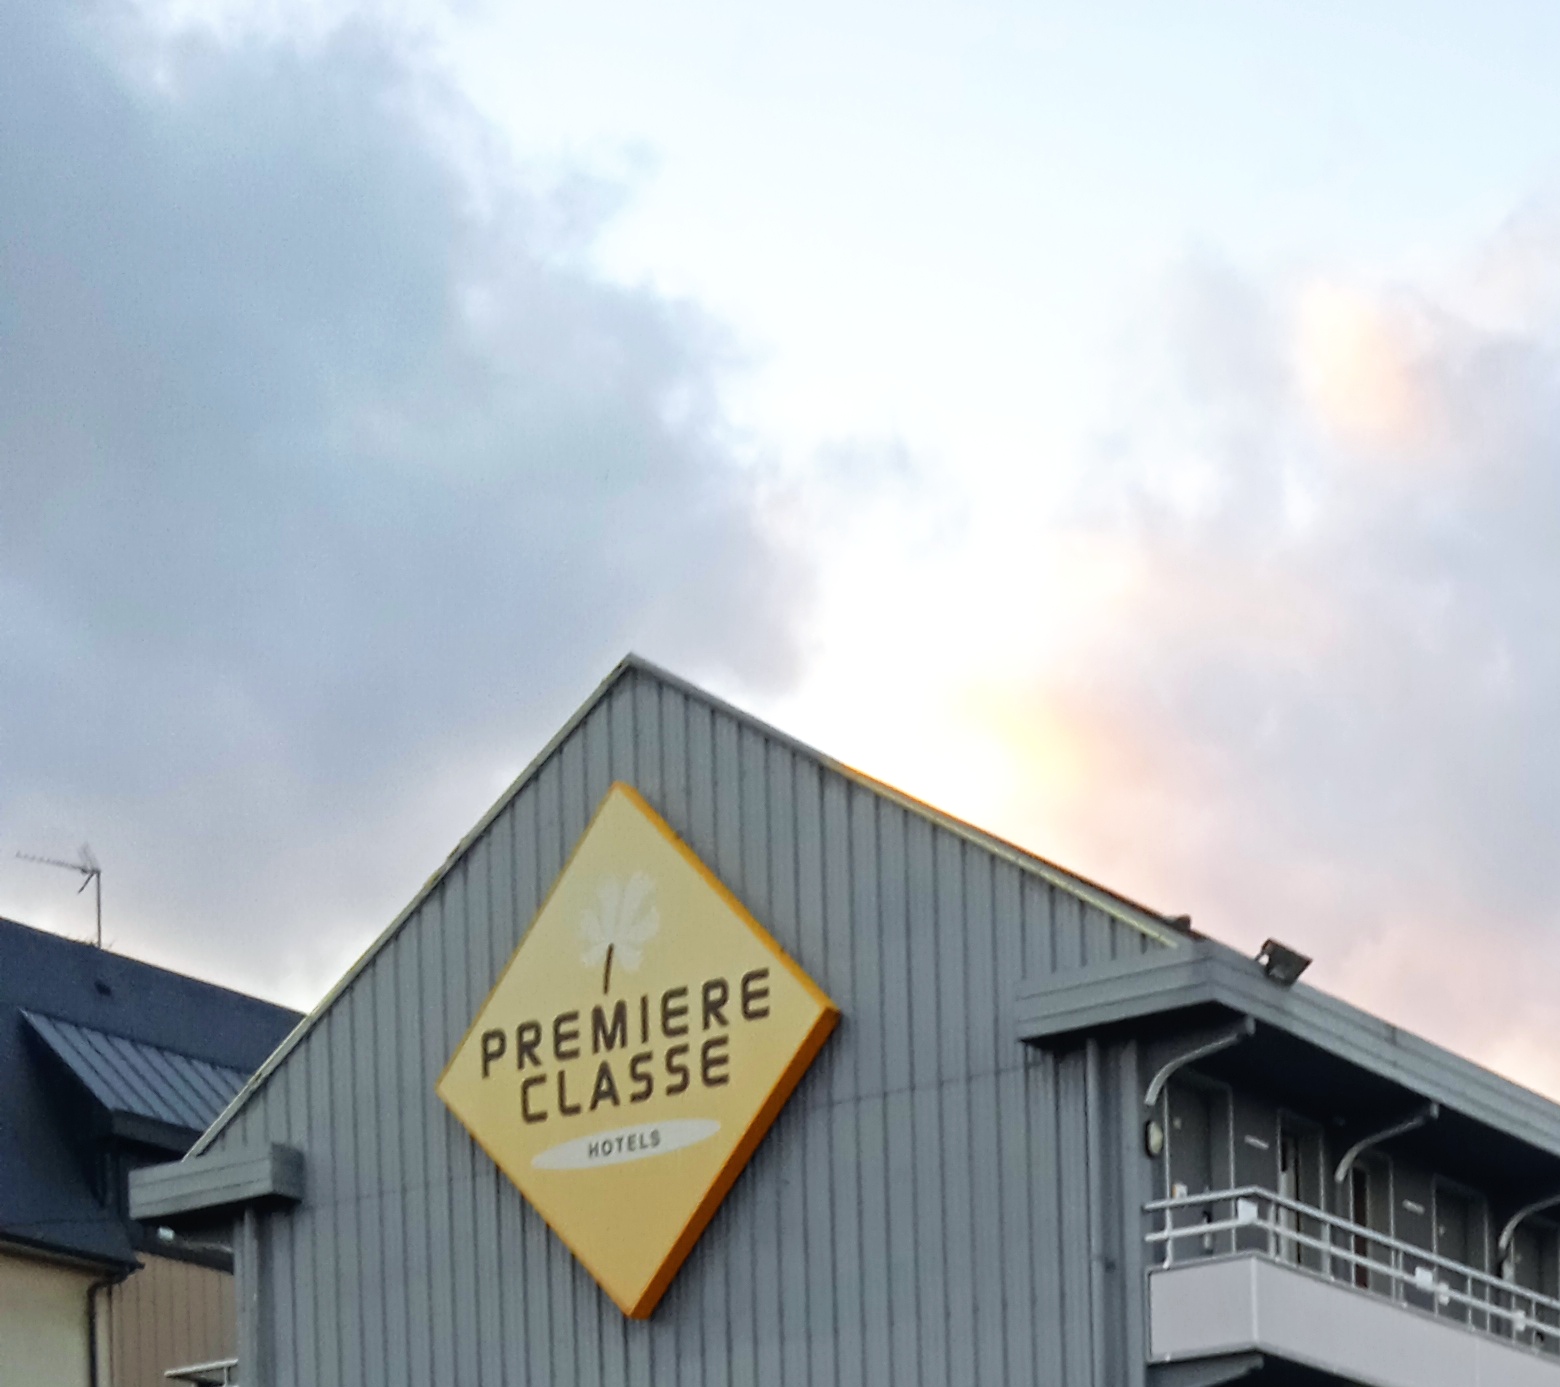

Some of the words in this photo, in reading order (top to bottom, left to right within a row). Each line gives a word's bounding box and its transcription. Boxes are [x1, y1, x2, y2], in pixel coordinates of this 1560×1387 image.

[480, 967, 771, 1079] PREMIERE
[520, 1035, 731, 1125] CLASSE
[587, 1129, 662, 1158] HOTELS
